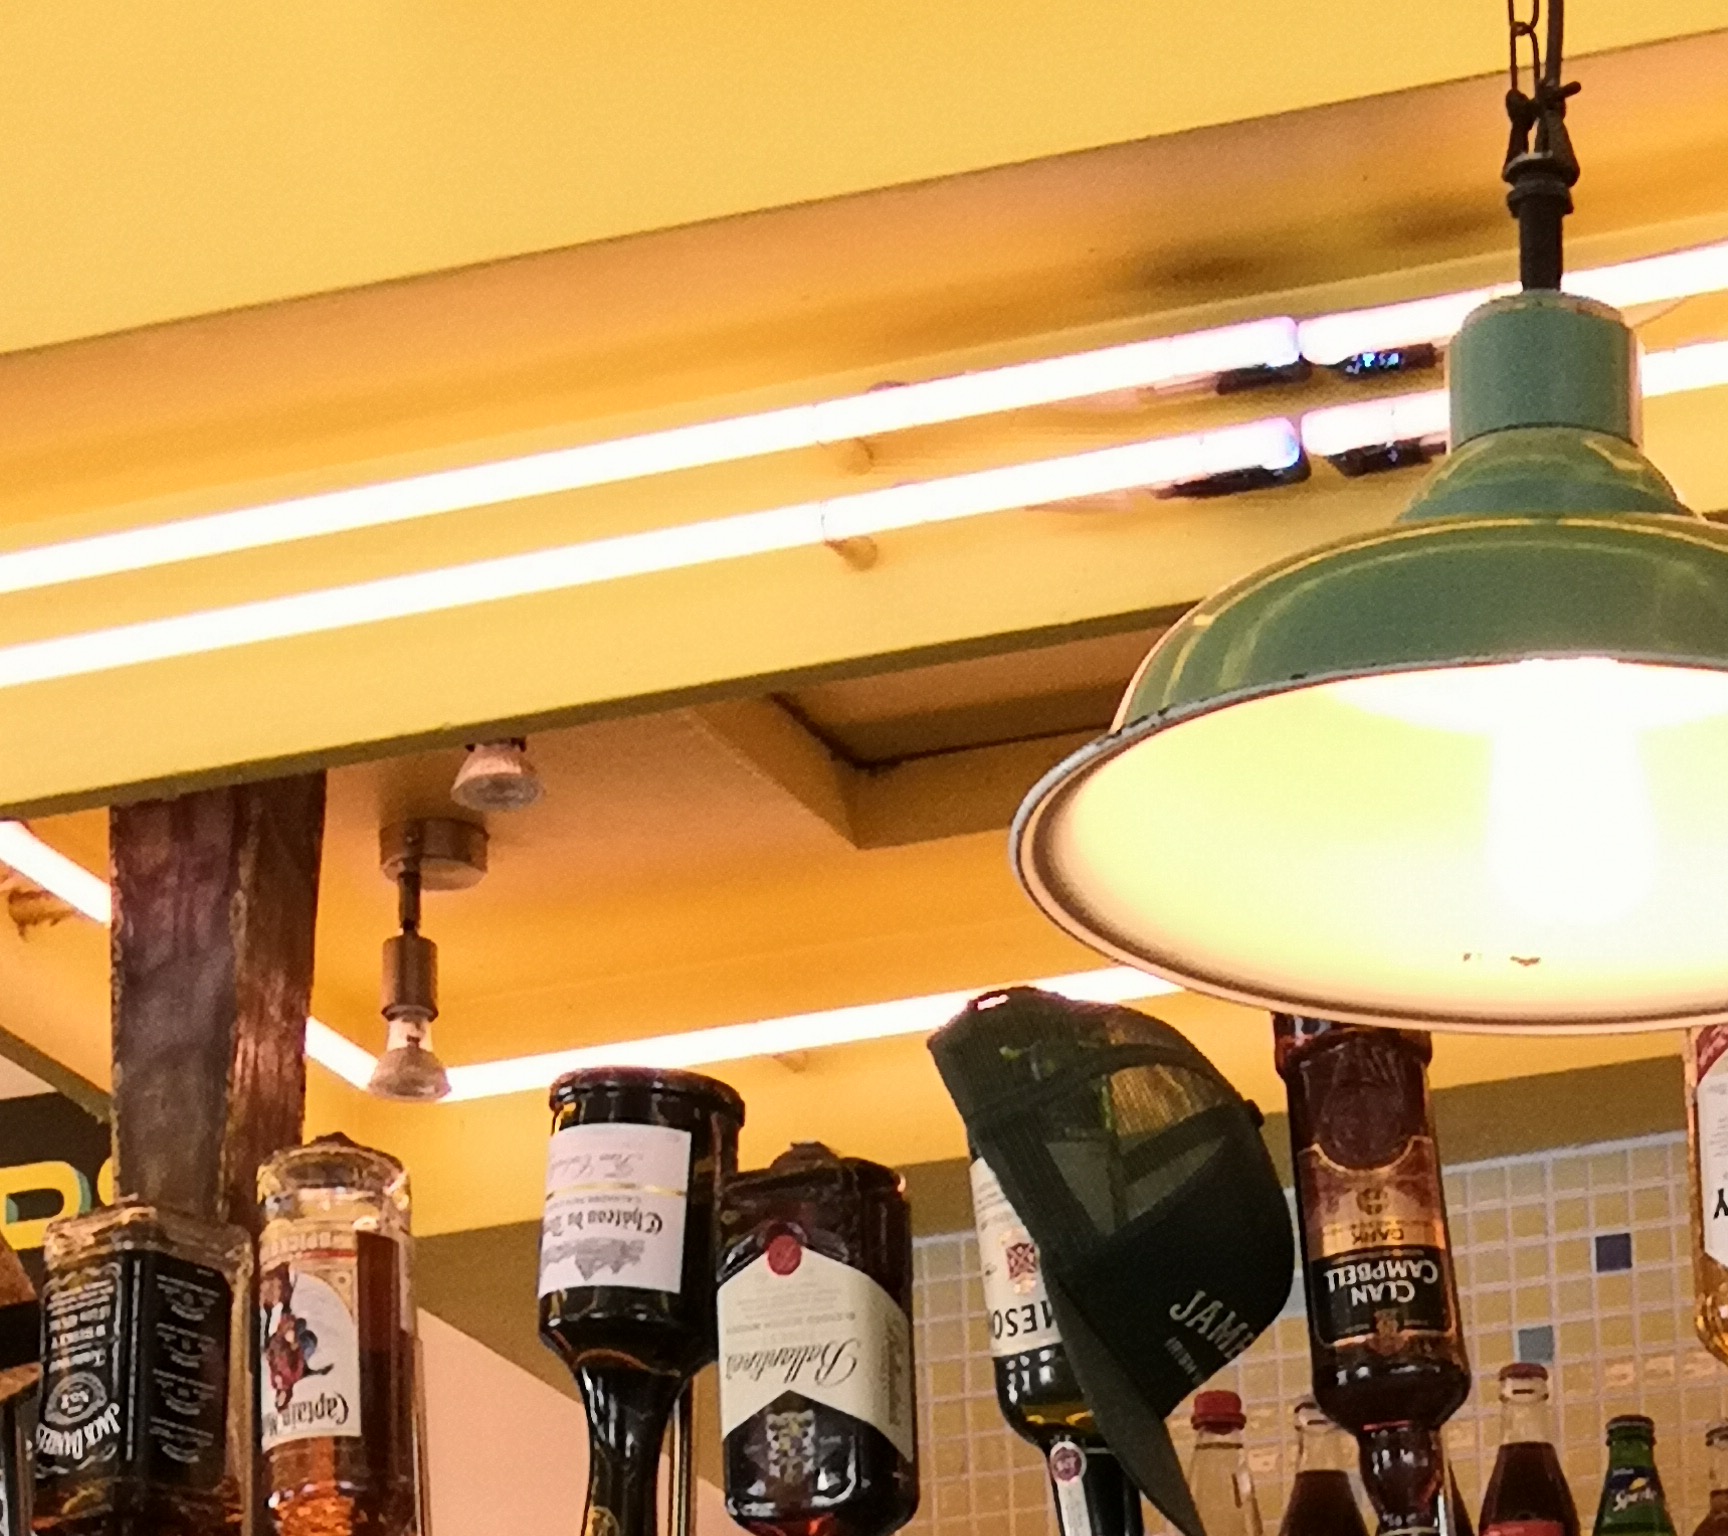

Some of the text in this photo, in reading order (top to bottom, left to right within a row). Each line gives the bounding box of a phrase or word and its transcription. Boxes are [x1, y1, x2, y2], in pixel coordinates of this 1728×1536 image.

[1323, 1259, 1440, 1294] CAMPBELL
[1351, 1279, 1417, 1307] CLAN
[1168, 1289, 1255, 1360] JAME
[282, 1392, 350, 1428] Captain
